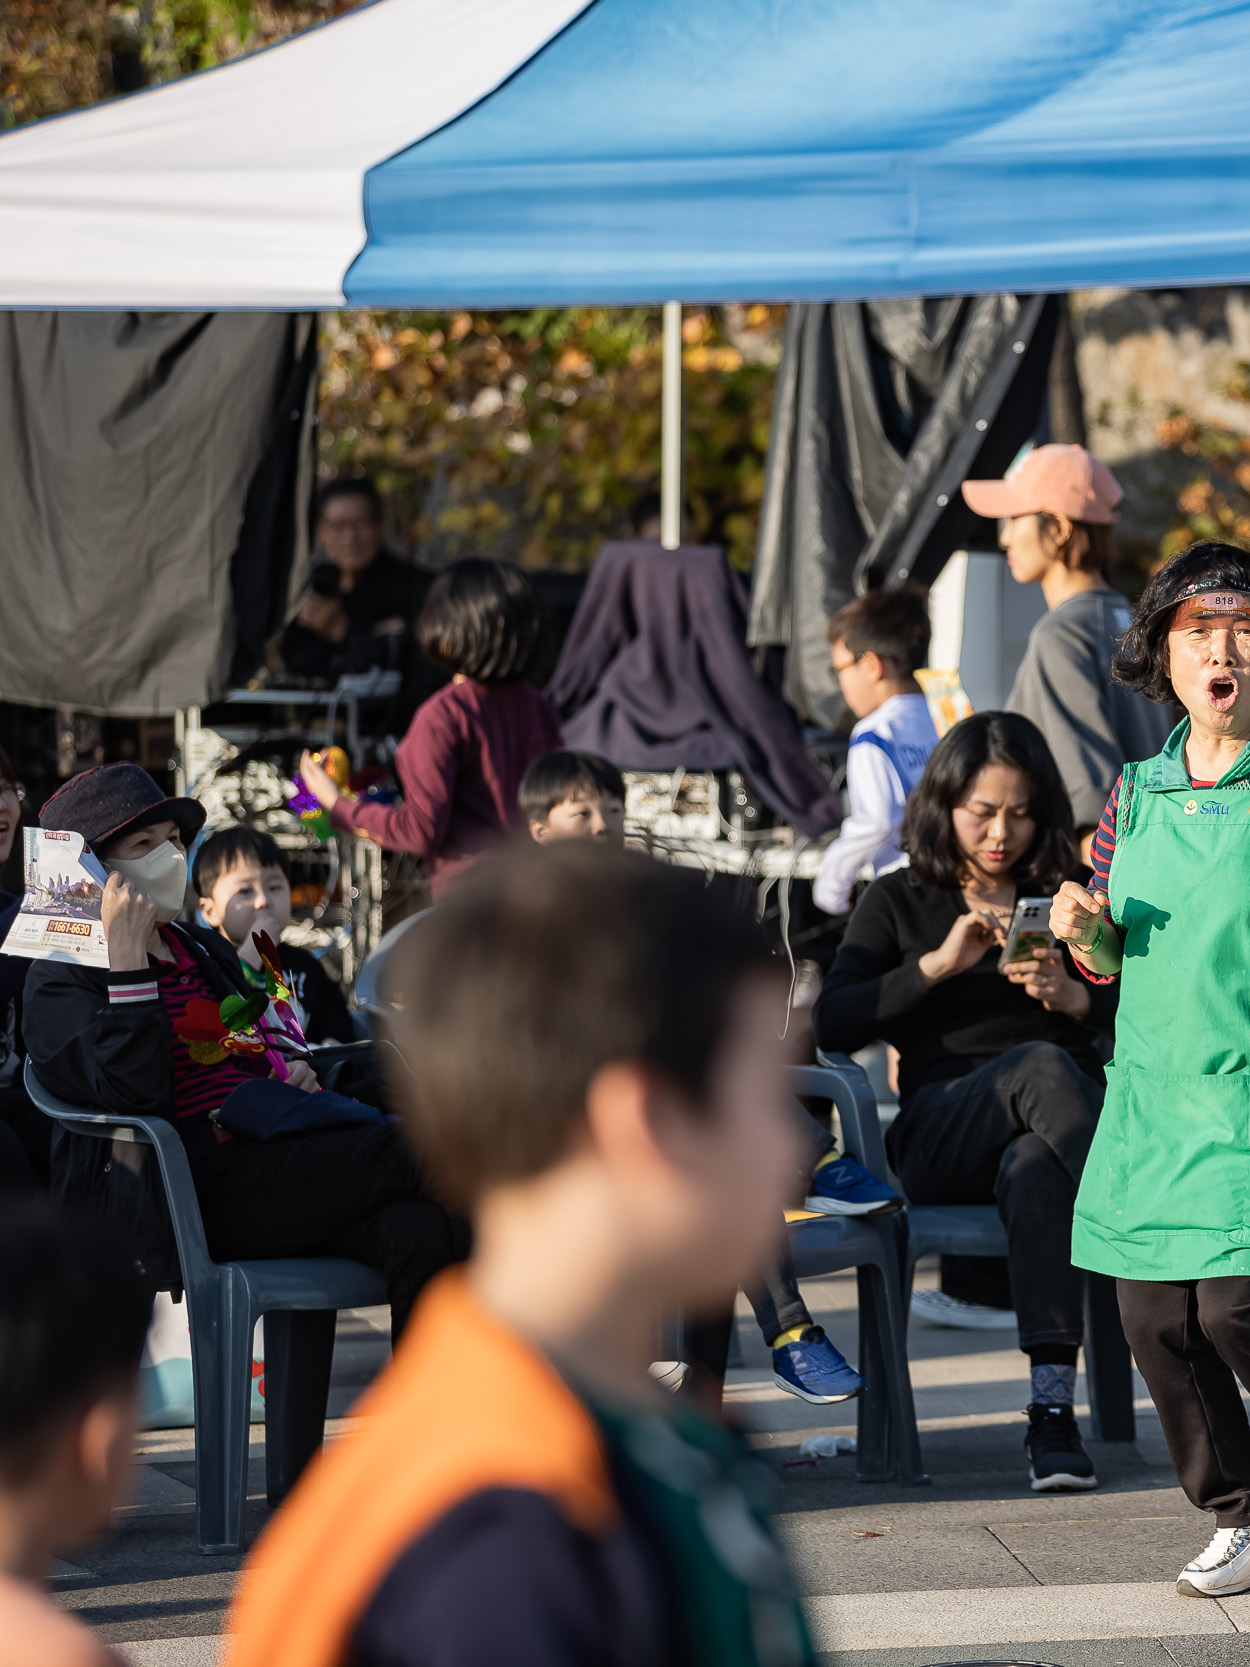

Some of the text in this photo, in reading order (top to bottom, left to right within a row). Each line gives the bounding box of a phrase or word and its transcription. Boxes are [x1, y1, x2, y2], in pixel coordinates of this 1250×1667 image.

[1215, 597, 1233, 605] 818
[1200, 803, 1230, 815] SMU
[54, 921, 90, 935] 1661-6630
